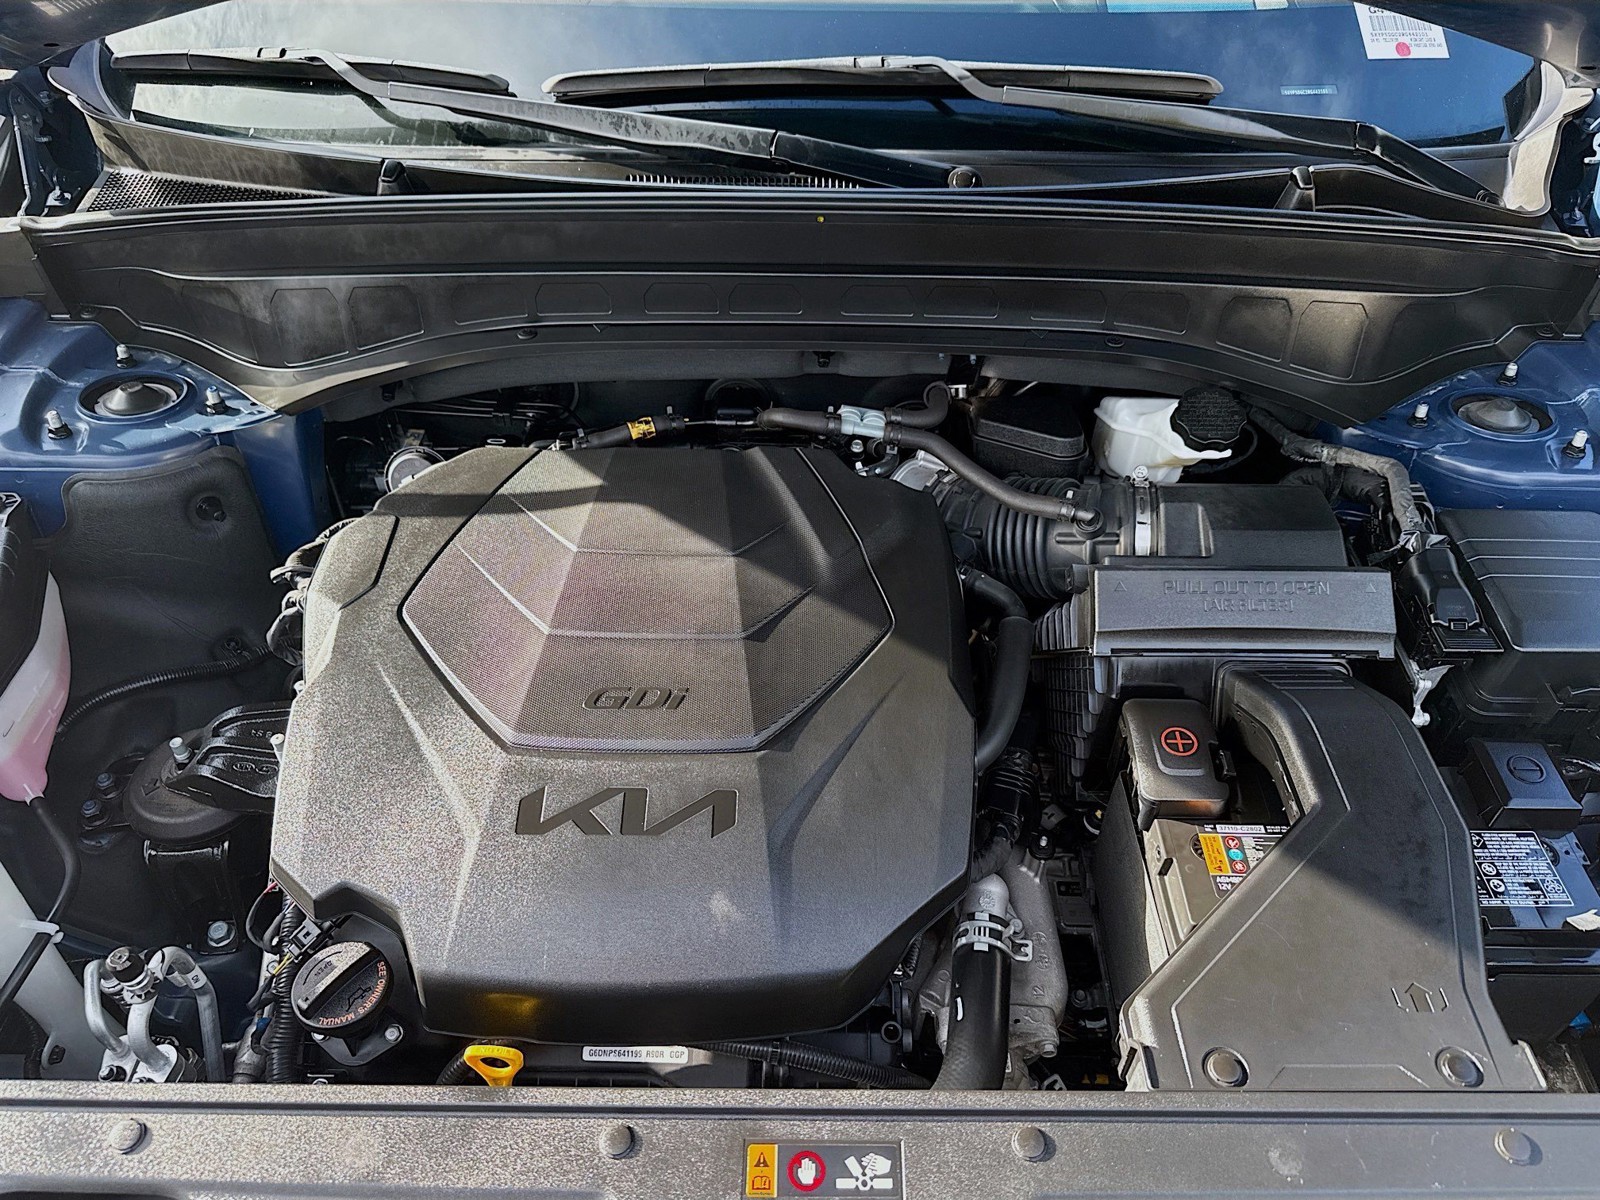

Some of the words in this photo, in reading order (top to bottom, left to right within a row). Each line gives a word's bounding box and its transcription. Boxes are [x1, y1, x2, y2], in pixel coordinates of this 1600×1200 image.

[1163, 580, 1209, 595] PULL
[1213, 580, 1248, 595] OUT
[1254, 580, 1277, 595] TO
[1283, 580, 1330, 595] OPEN
[582, 686, 689, 711] GDi
[515, 786, 739, 838] KIA
[377, 961, 387, 978] SEE
[357, 979, 386, 1014] OWNER'S
[319, 1012, 356, 1025] MANUAL
